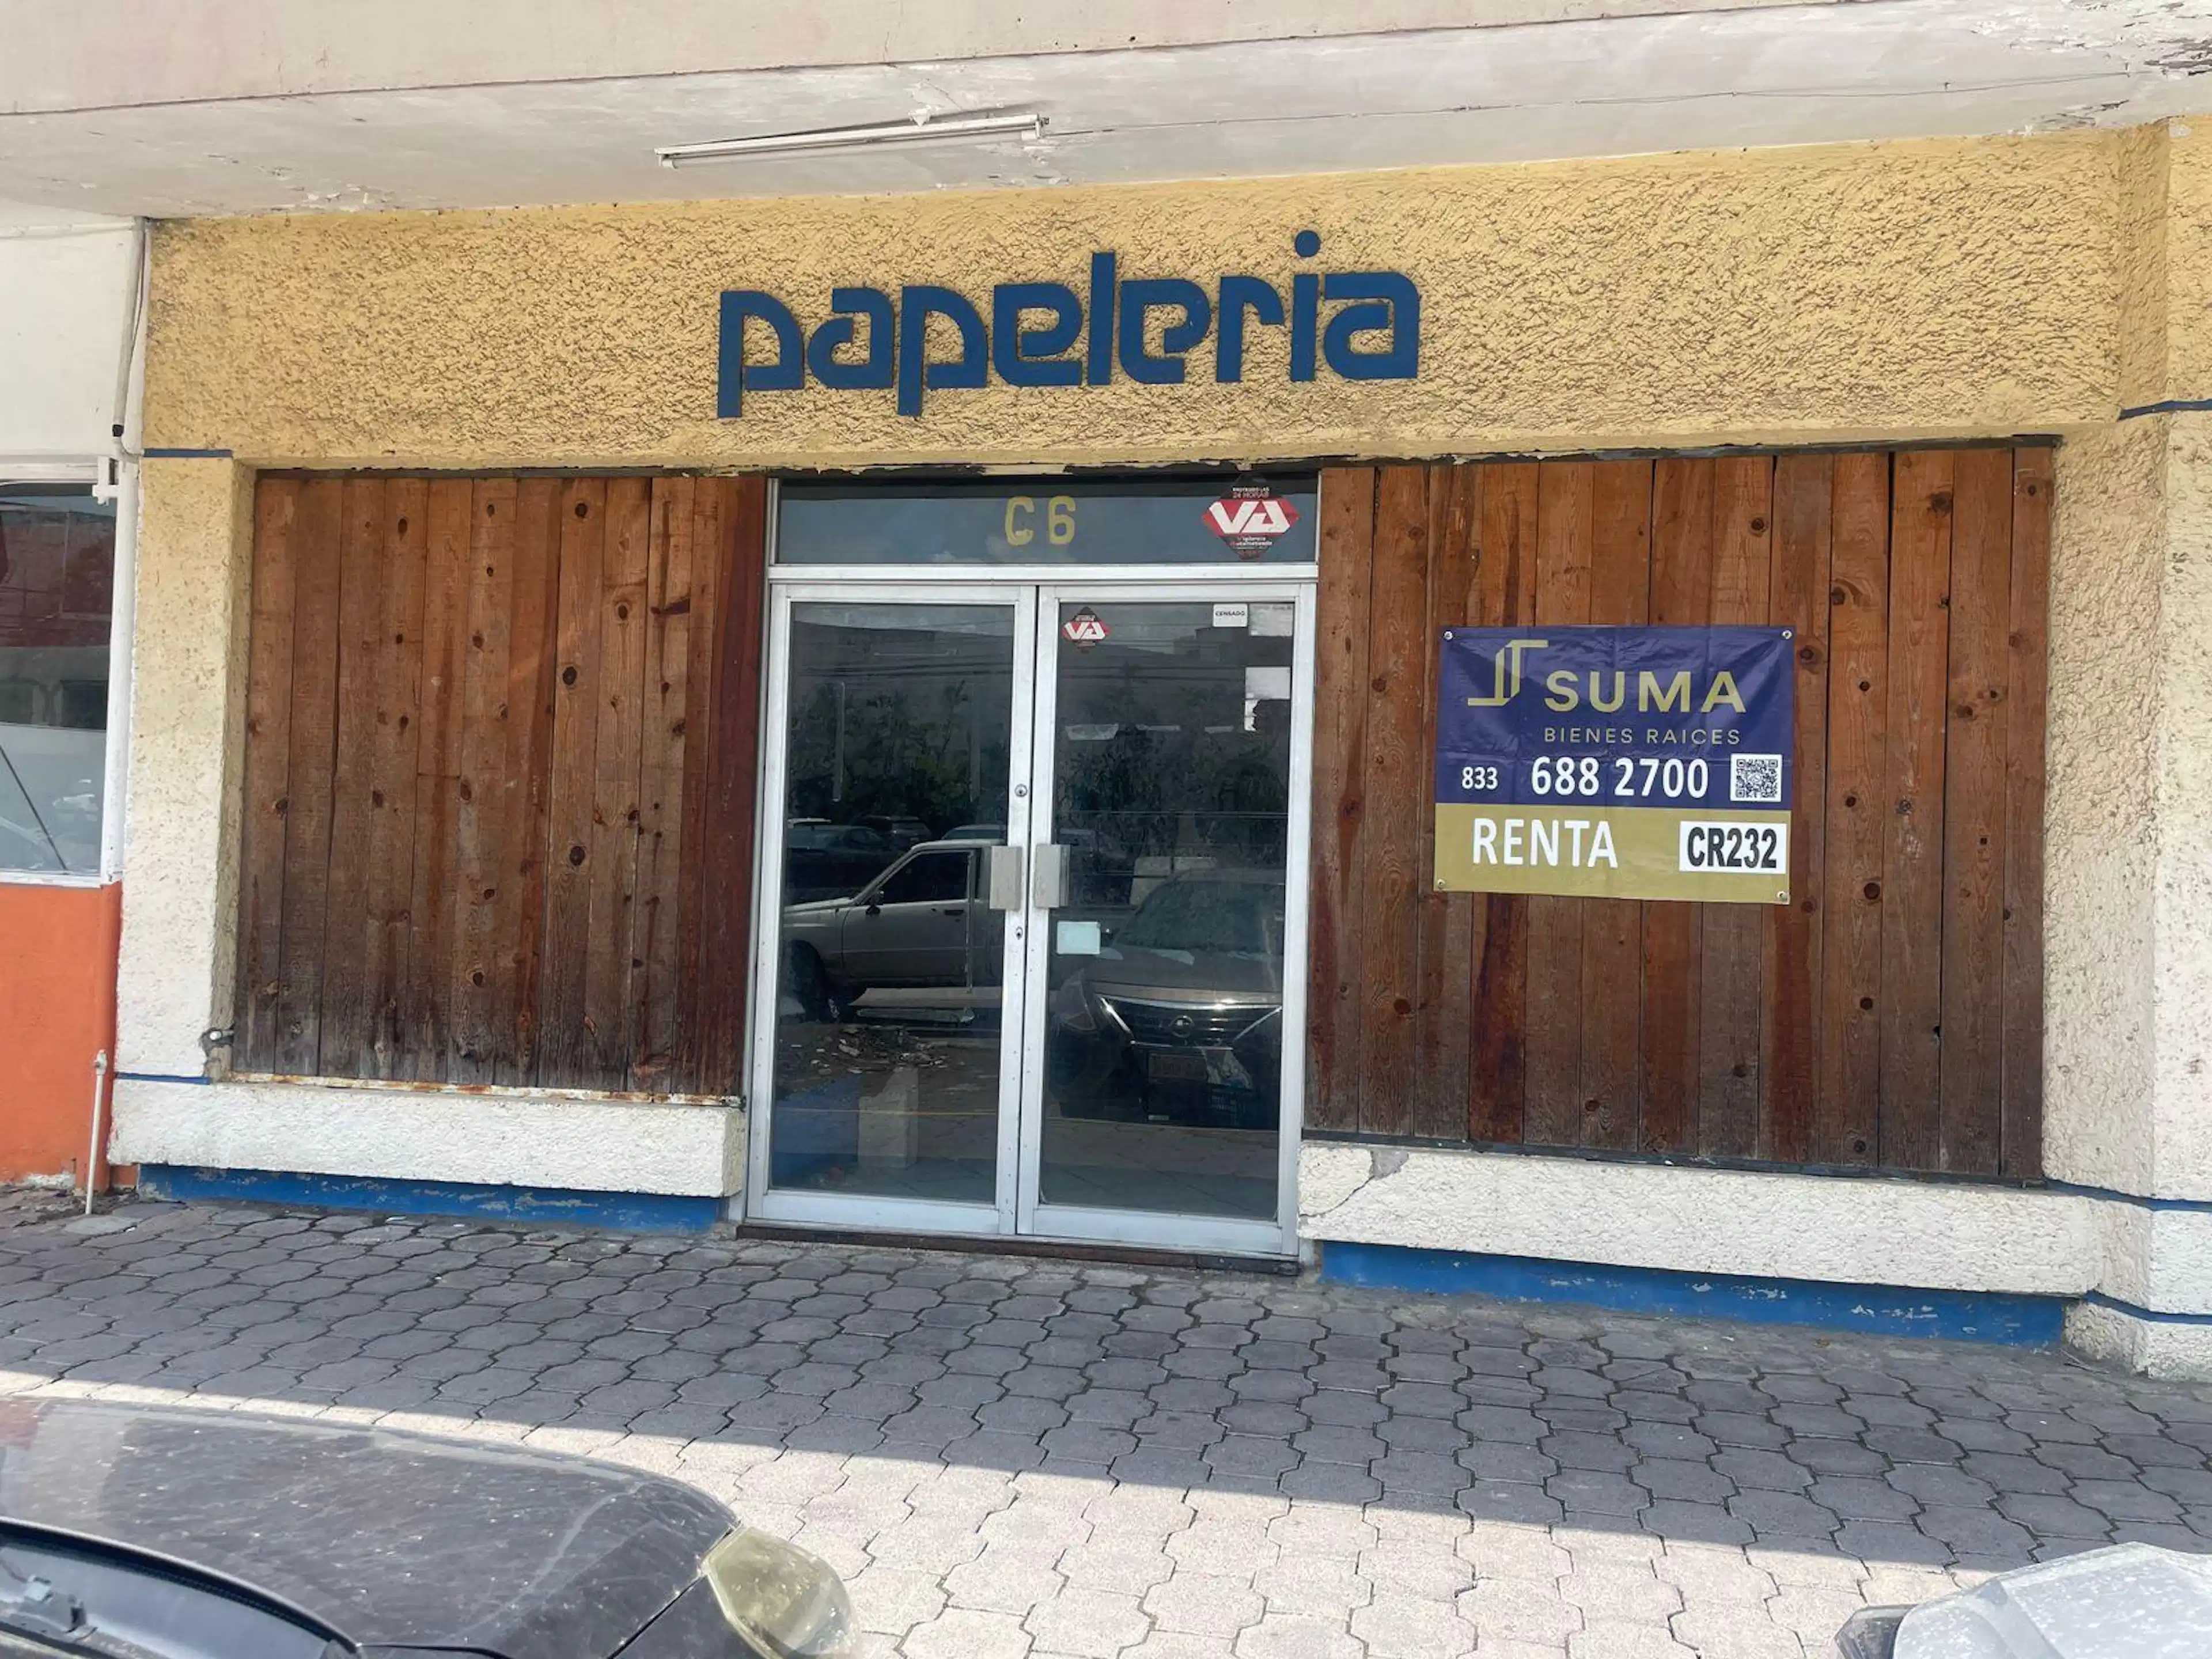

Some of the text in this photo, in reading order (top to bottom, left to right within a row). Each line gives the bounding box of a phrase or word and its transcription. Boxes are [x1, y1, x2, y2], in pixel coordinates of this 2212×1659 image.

[717, 230, 1420, 418] papeleria
[1209, 501, 1290, 534] VA
[1544, 670, 1747, 713] SUMA
[1544, 728, 1741, 745] BIENES RAICES
[1461, 756, 1709, 798] 833 688 2700
[1473, 818, 1778, 869] RENTA CR232
